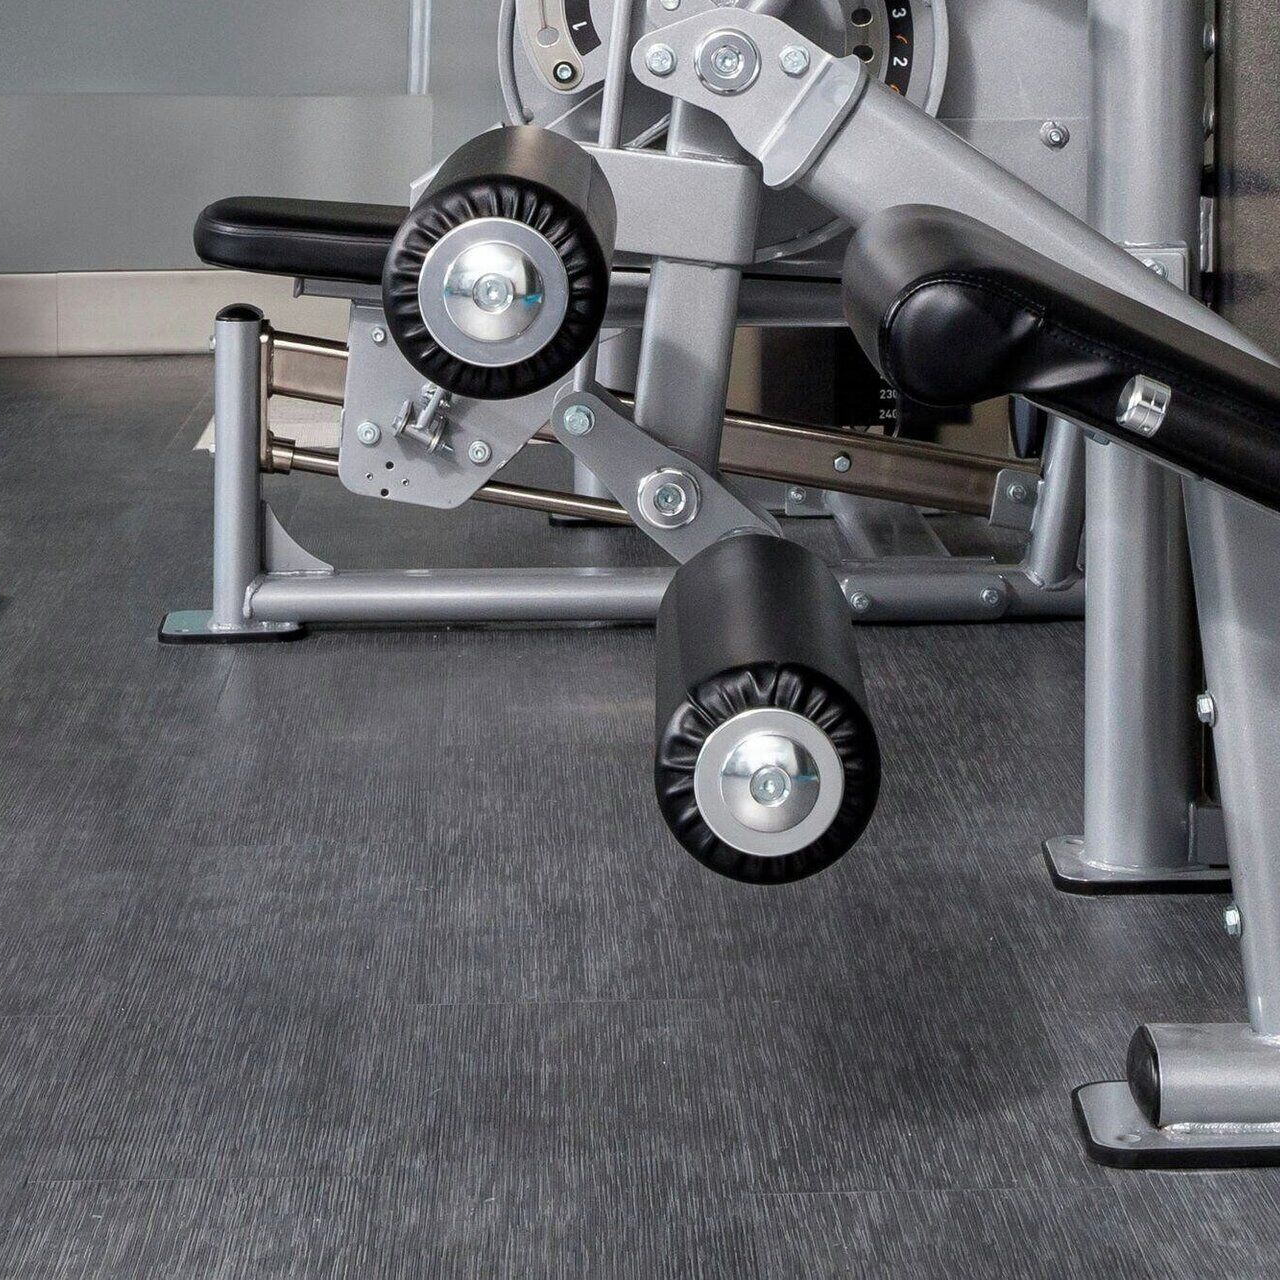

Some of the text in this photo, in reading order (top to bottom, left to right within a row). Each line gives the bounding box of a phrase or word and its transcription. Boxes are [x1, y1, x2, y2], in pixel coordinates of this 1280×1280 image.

[891, 7, 907, 19] 3
[572, 20, 588, 31] 1
[892, 56, 909, 67] 2
[879, 389, 898, 399] 230
